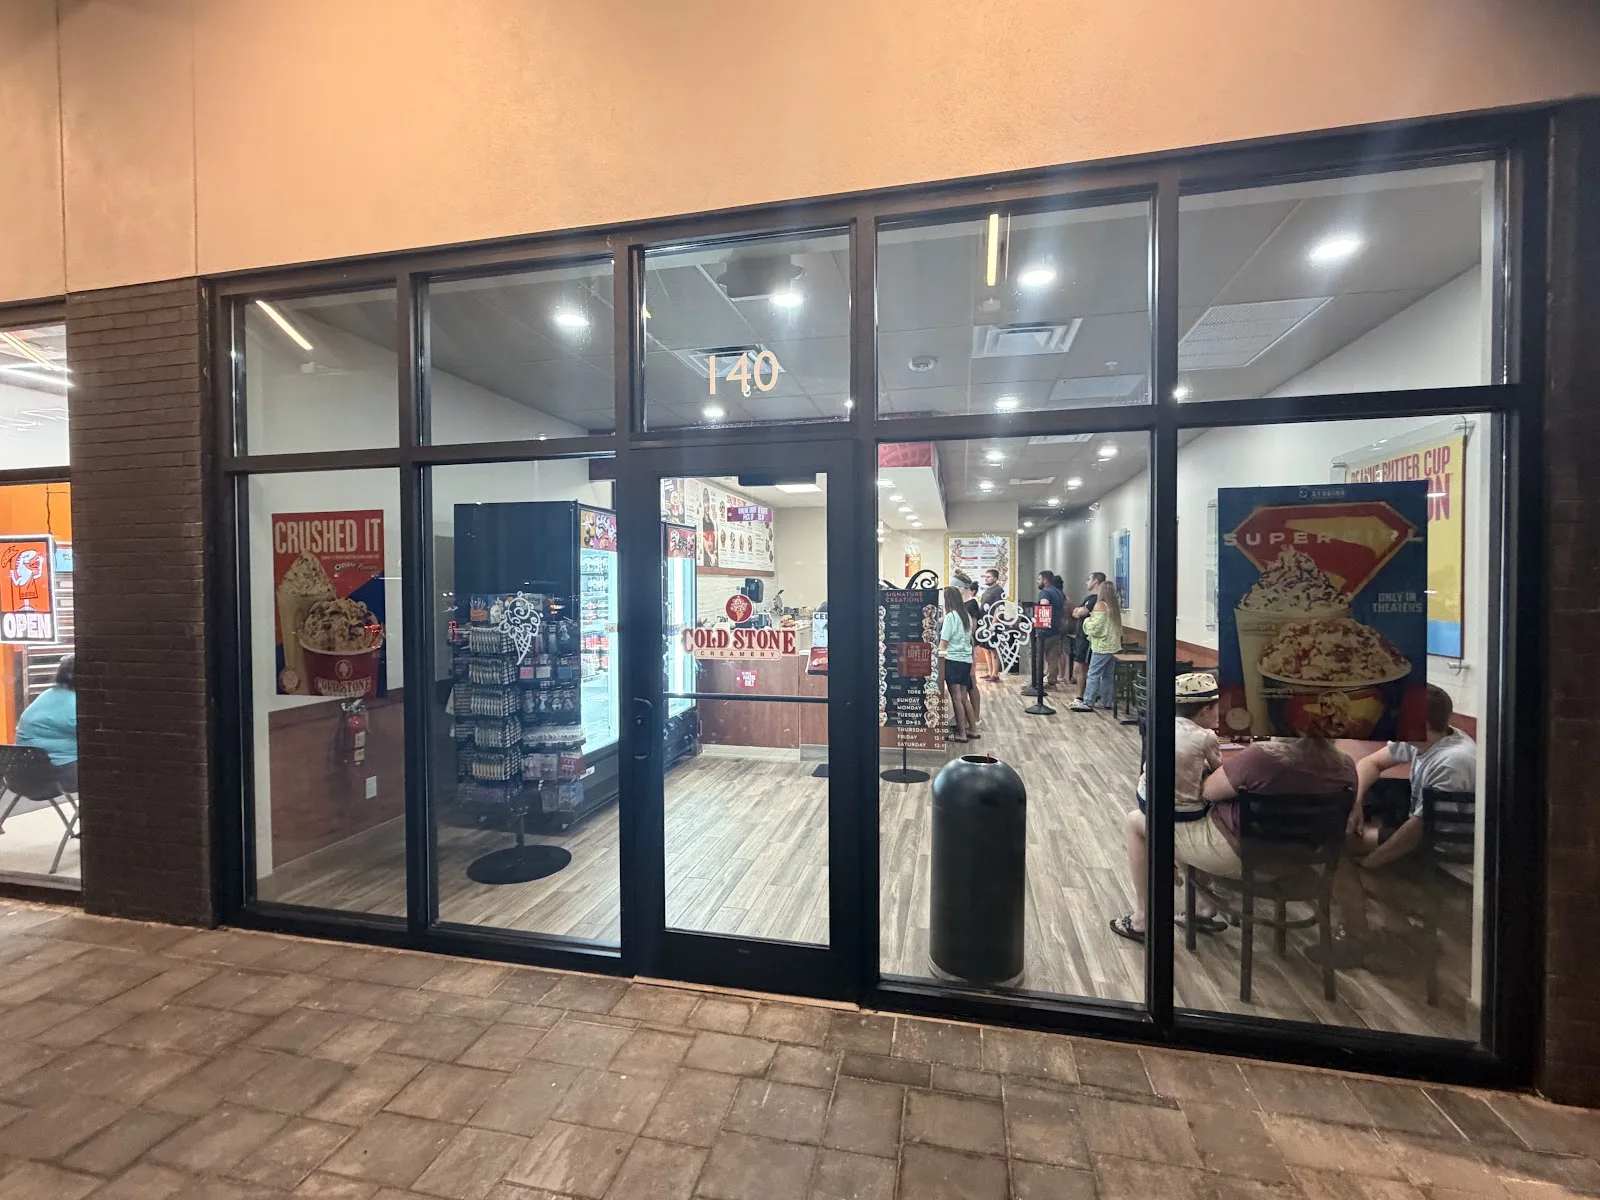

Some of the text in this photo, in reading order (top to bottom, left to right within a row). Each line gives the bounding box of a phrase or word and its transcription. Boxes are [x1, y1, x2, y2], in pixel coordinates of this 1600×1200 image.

[709, 350, 779, 395] 140
[1382, 453, 1420, 482] BUTTER
[1424, 445, 1451, 476] CUP
[274, 518, 381, 554] CRUSHED IT
[1372, 602, 1424, 612] THEATERS
[1378, 592, 1403, 601] ONLY
[3, 613, 52, 638] OPEN
[682, 629, 796, 654] COLD STONE
